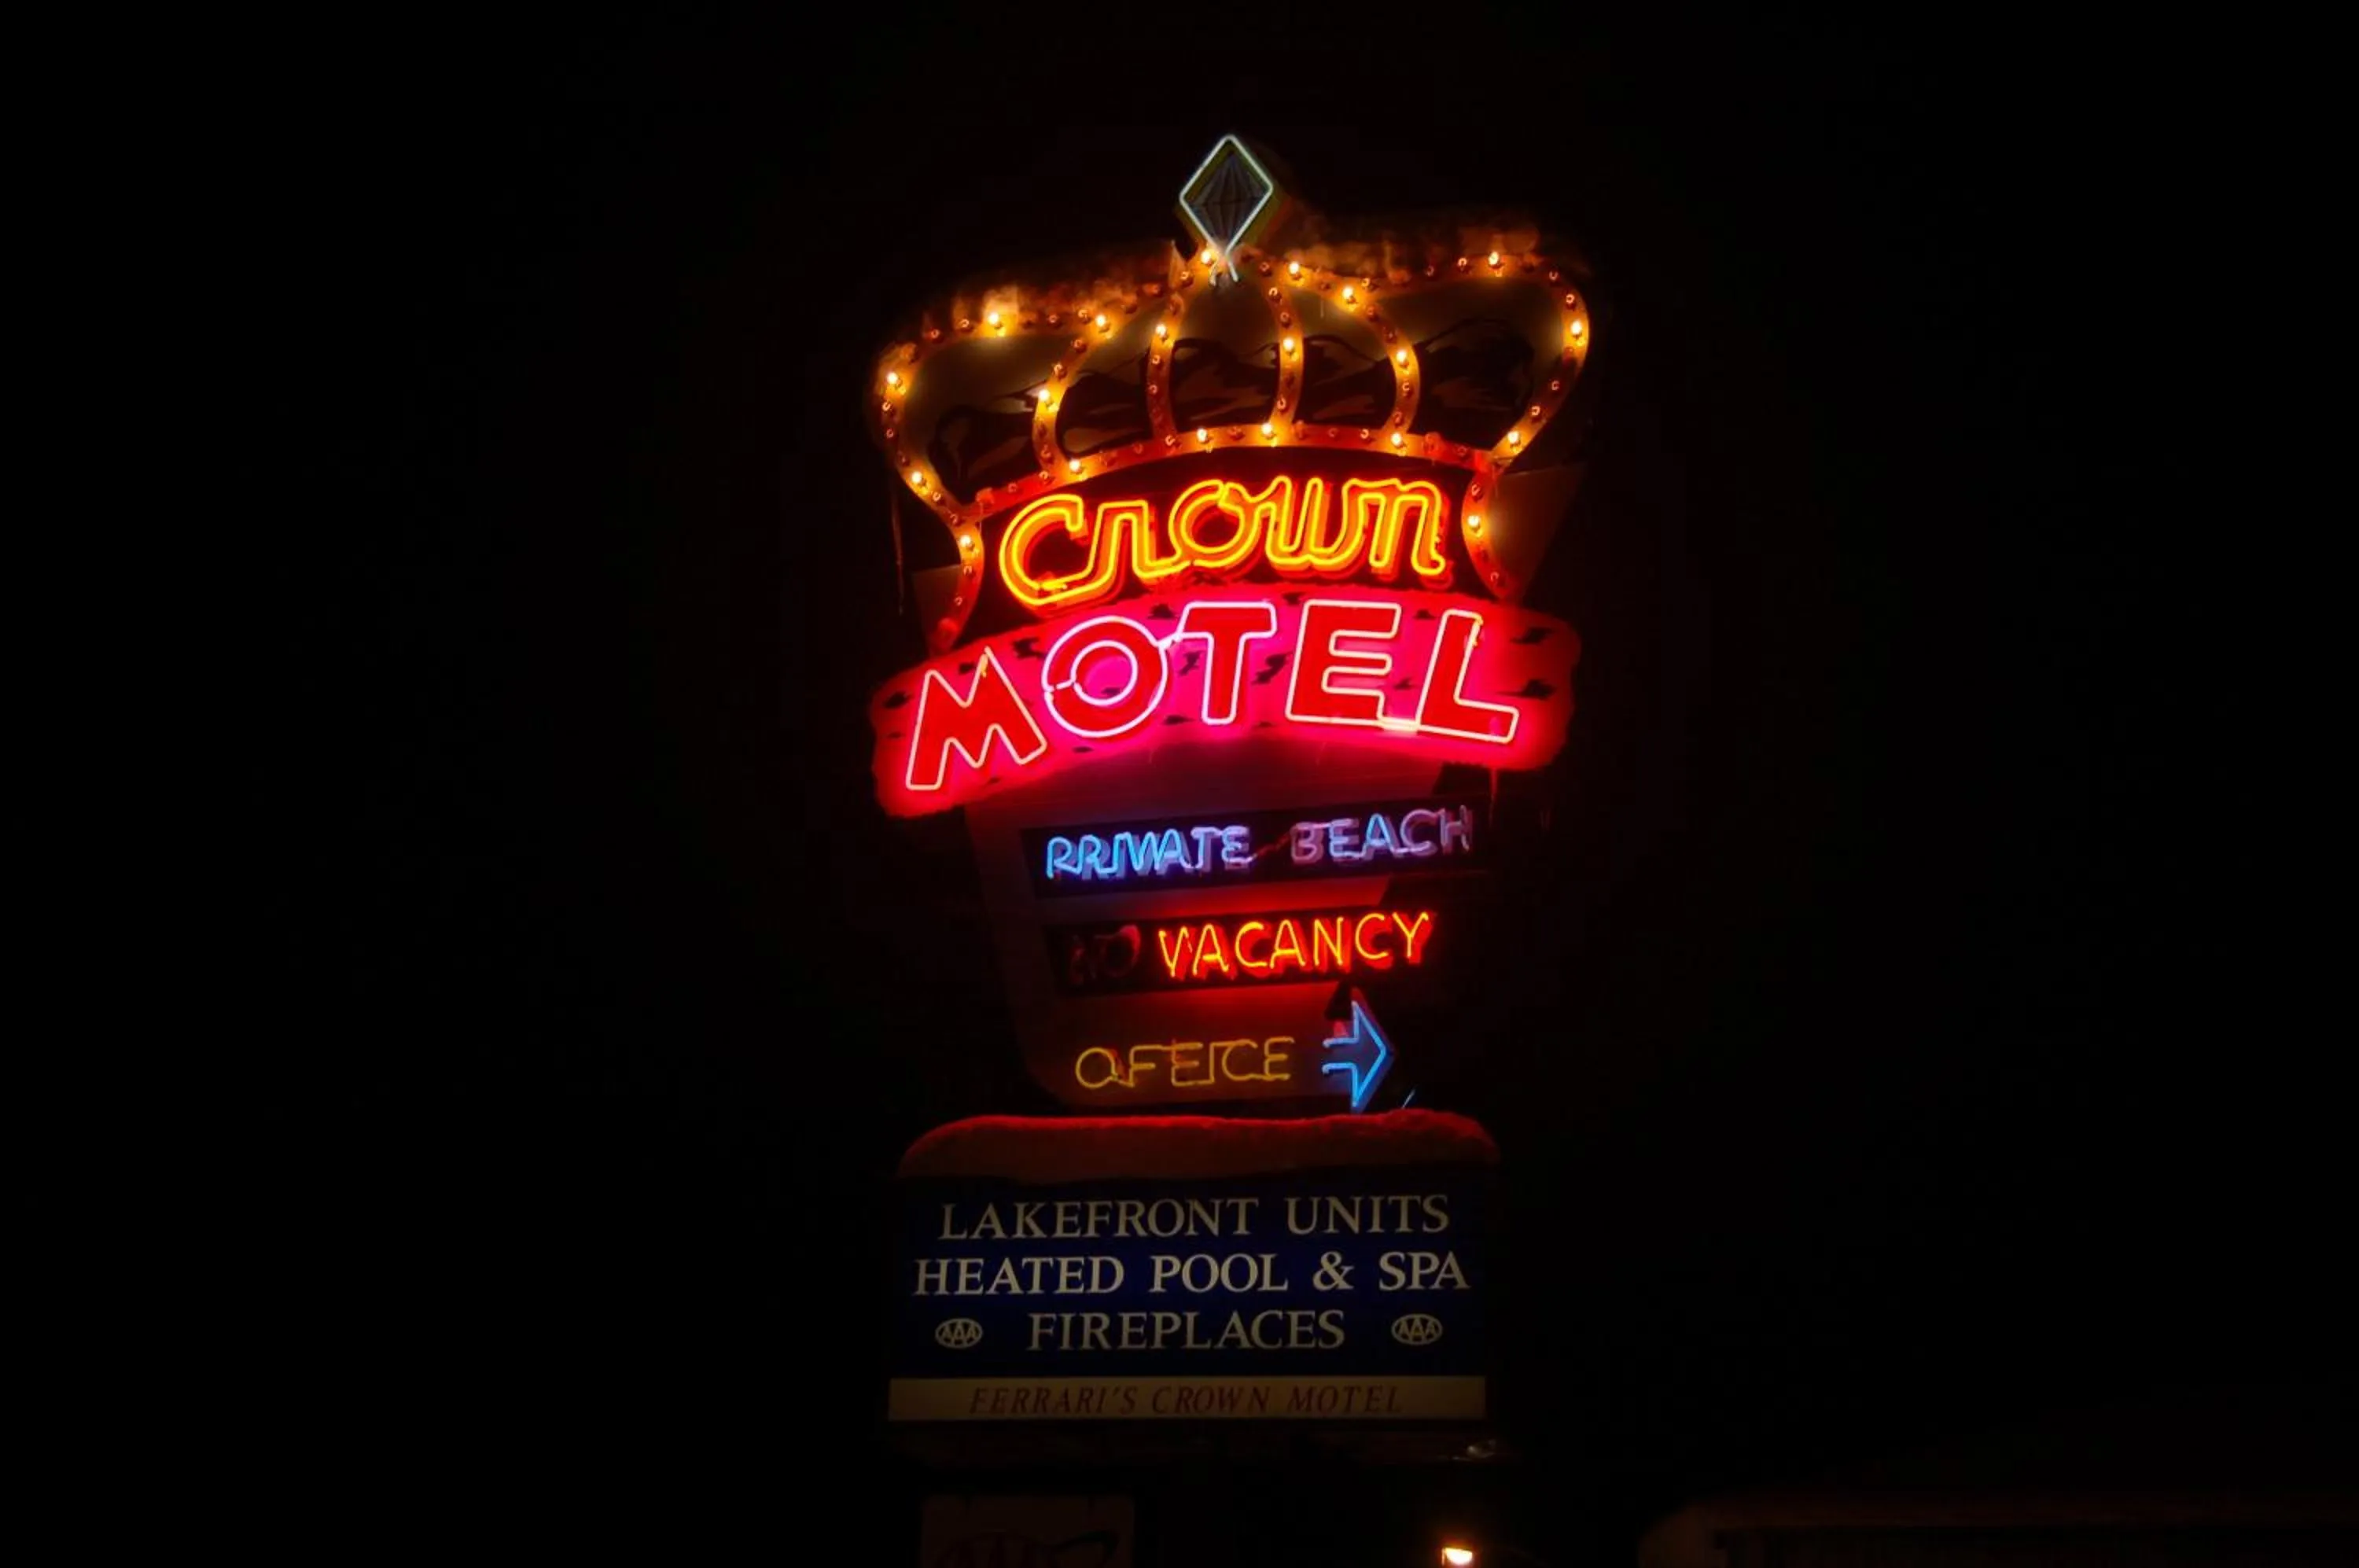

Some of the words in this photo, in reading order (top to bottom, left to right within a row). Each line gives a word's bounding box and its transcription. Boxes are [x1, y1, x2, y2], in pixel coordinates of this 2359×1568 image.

[999, 475, 1452, 612] Crown
[904, 598, 1521, 792] MOTEL
[1047, 823, 1256, 880] PRIVATE
[1290, 804, 1473, 865] BEACH
[1158, 910, 1434, 981] VACANCY
[1075, 1034, 1295, 1088] OFFICE
[938, 1198, 1259, 1240] LAKEFRONT
[1283, 1194, 1450, 1235] UNITS
[912, 1256, 1125, 1296] HEATED
[1149, 1253, 1290, 1294] POOL
[1312, 1250, 1356, 1292] &
[1378, 1250, 1472, 1291] SPA
[935, 1318, 984, 1349] AAA
[1026, 1309, 1346, 1351] FIREPLACES
[1391, 1312, 1444, 1346] AAA
[970, 1386, 1138, 1415] FERRARI'S
[1152, 1385, 1271, 1414] CROWN
[1286, 1384, 1404, 1413] MOTEL
